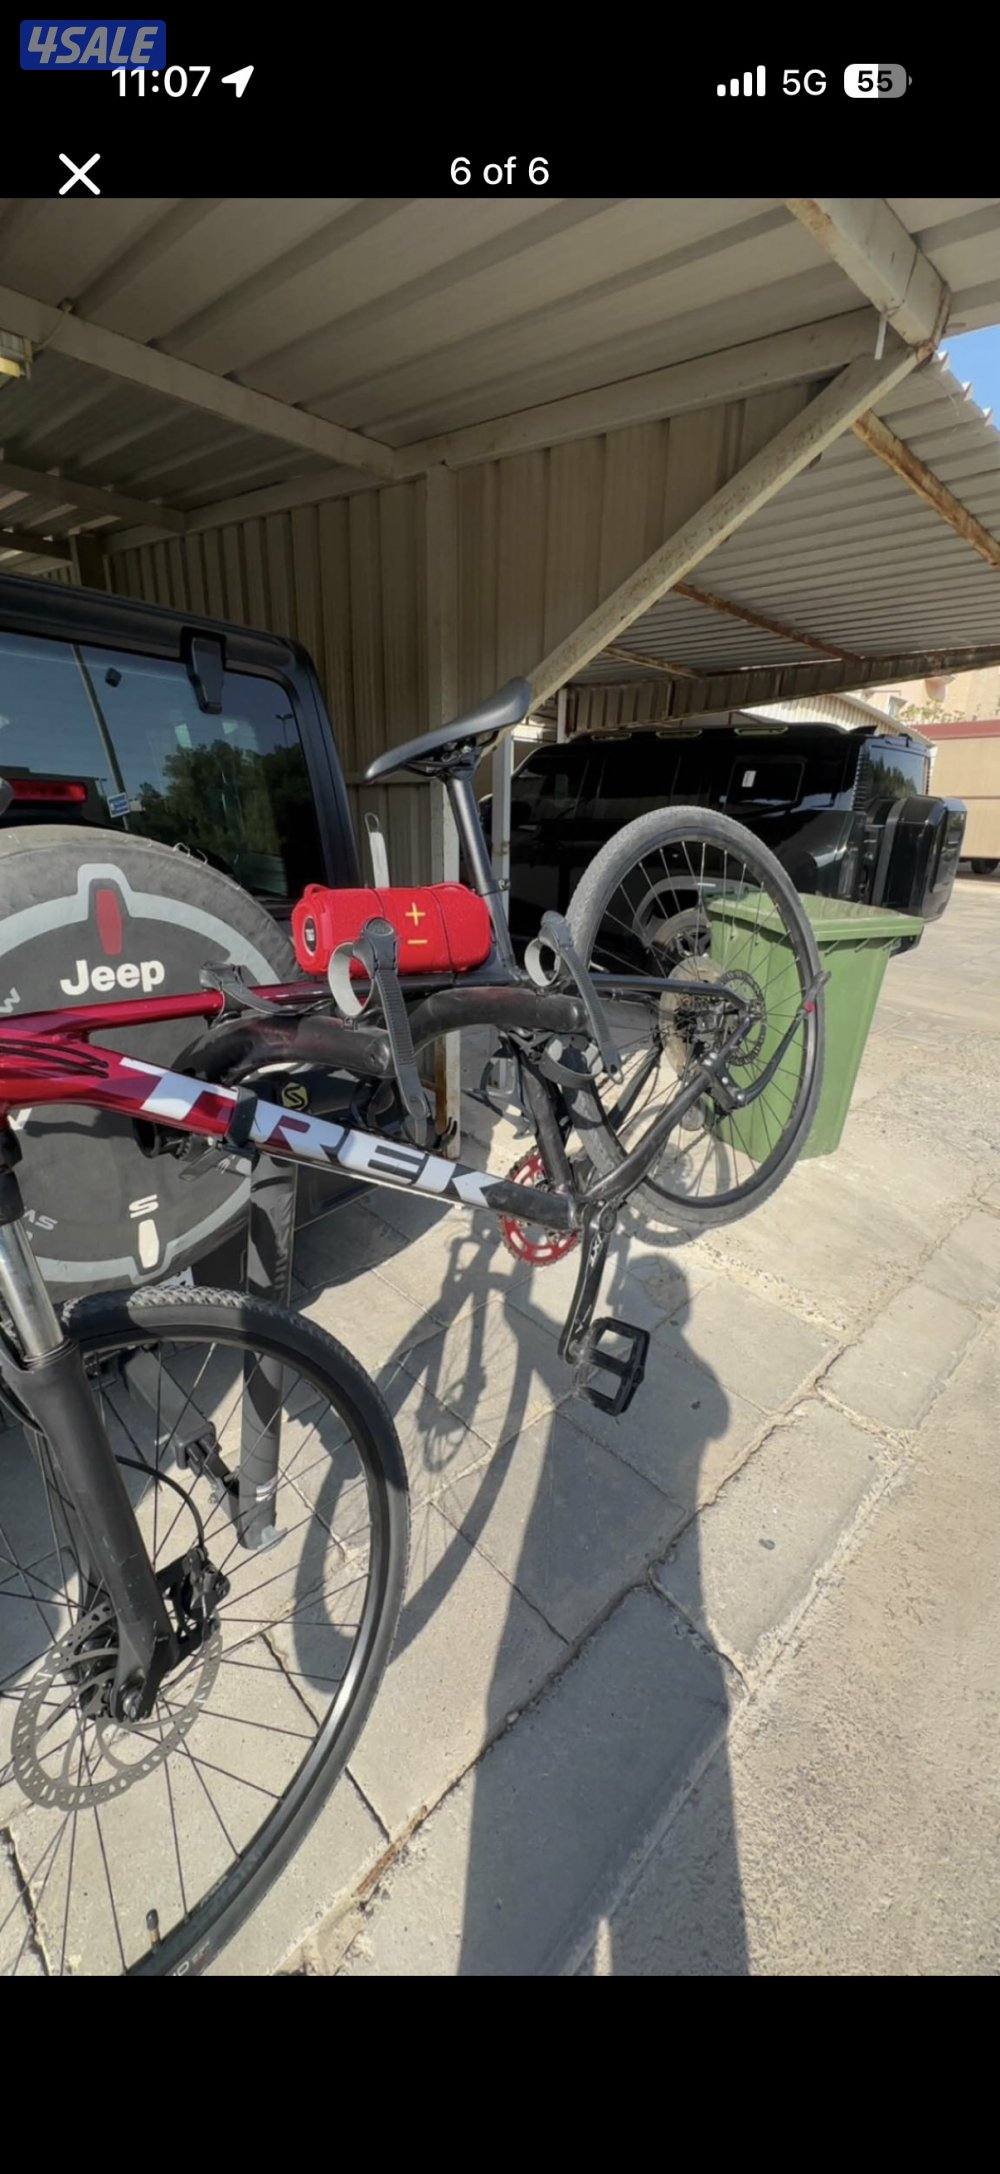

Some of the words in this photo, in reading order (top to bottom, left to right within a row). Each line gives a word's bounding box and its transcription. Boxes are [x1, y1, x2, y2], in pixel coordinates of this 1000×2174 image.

[60, 959, 166, 996] Jeep
[118, 1056, 501, 1208] TREK
[128, 1194, 160, 1219] S
